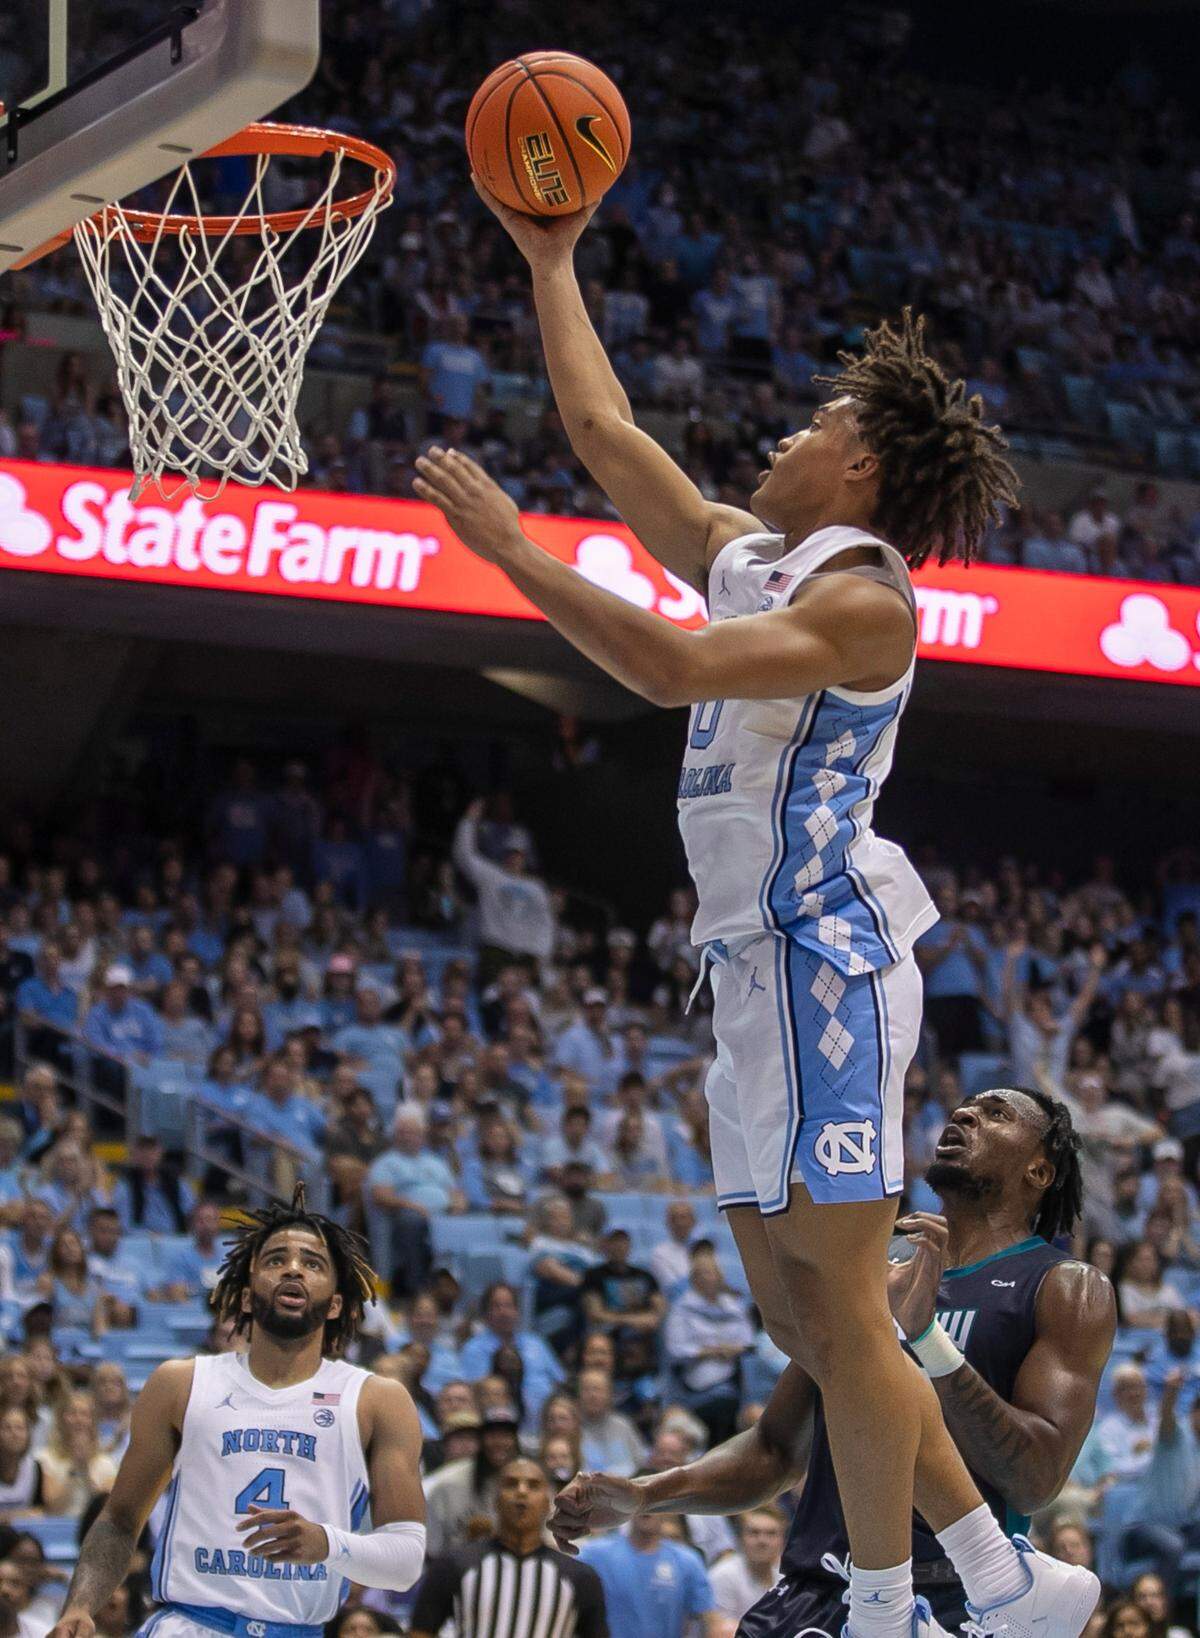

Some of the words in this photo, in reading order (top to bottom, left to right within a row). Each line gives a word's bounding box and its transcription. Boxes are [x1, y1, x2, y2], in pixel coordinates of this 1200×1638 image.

[525, 131, 571, 207] ELITE
[221, 1428, 317, 1462] NORTH
[234, 1467, 290, 1530] 4
[194, 1547, 327, 1581] CAROLINA
